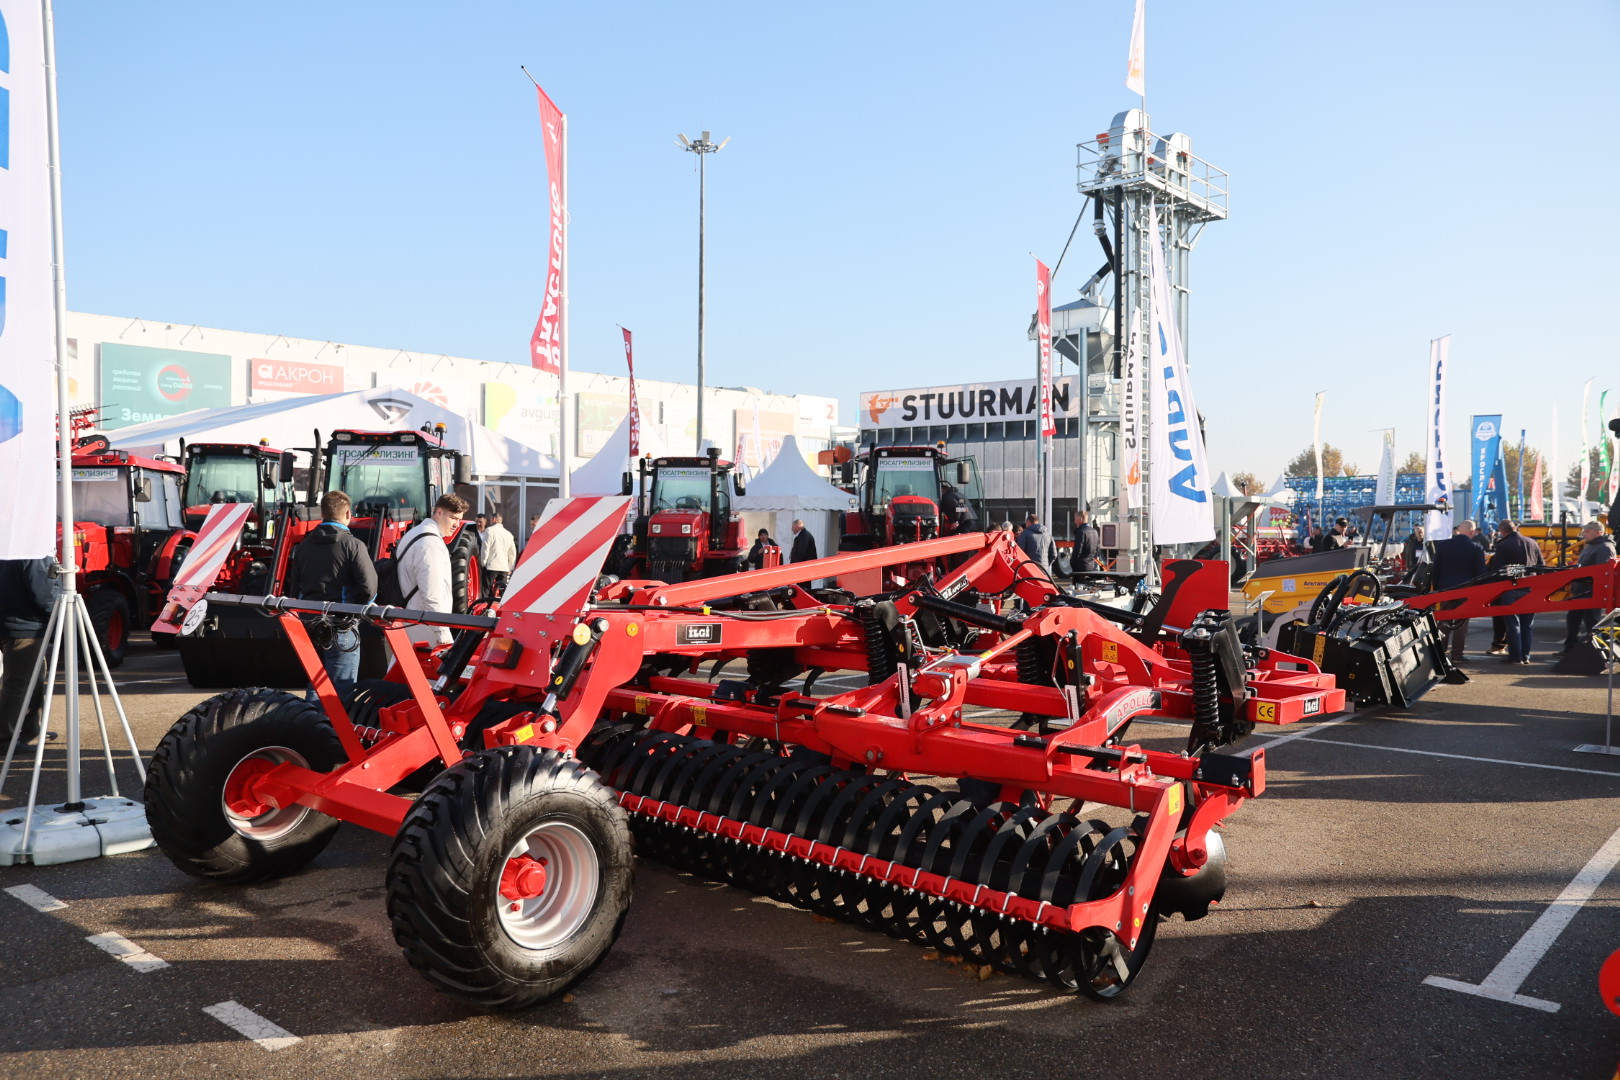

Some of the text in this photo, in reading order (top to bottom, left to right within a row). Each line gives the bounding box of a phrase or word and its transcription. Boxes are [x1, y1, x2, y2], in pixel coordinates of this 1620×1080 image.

[275, 366, 333, 385] АКРОН
[826, 404, 834, 419] 2
[1115, 692, 1154, 723] APOLLO
